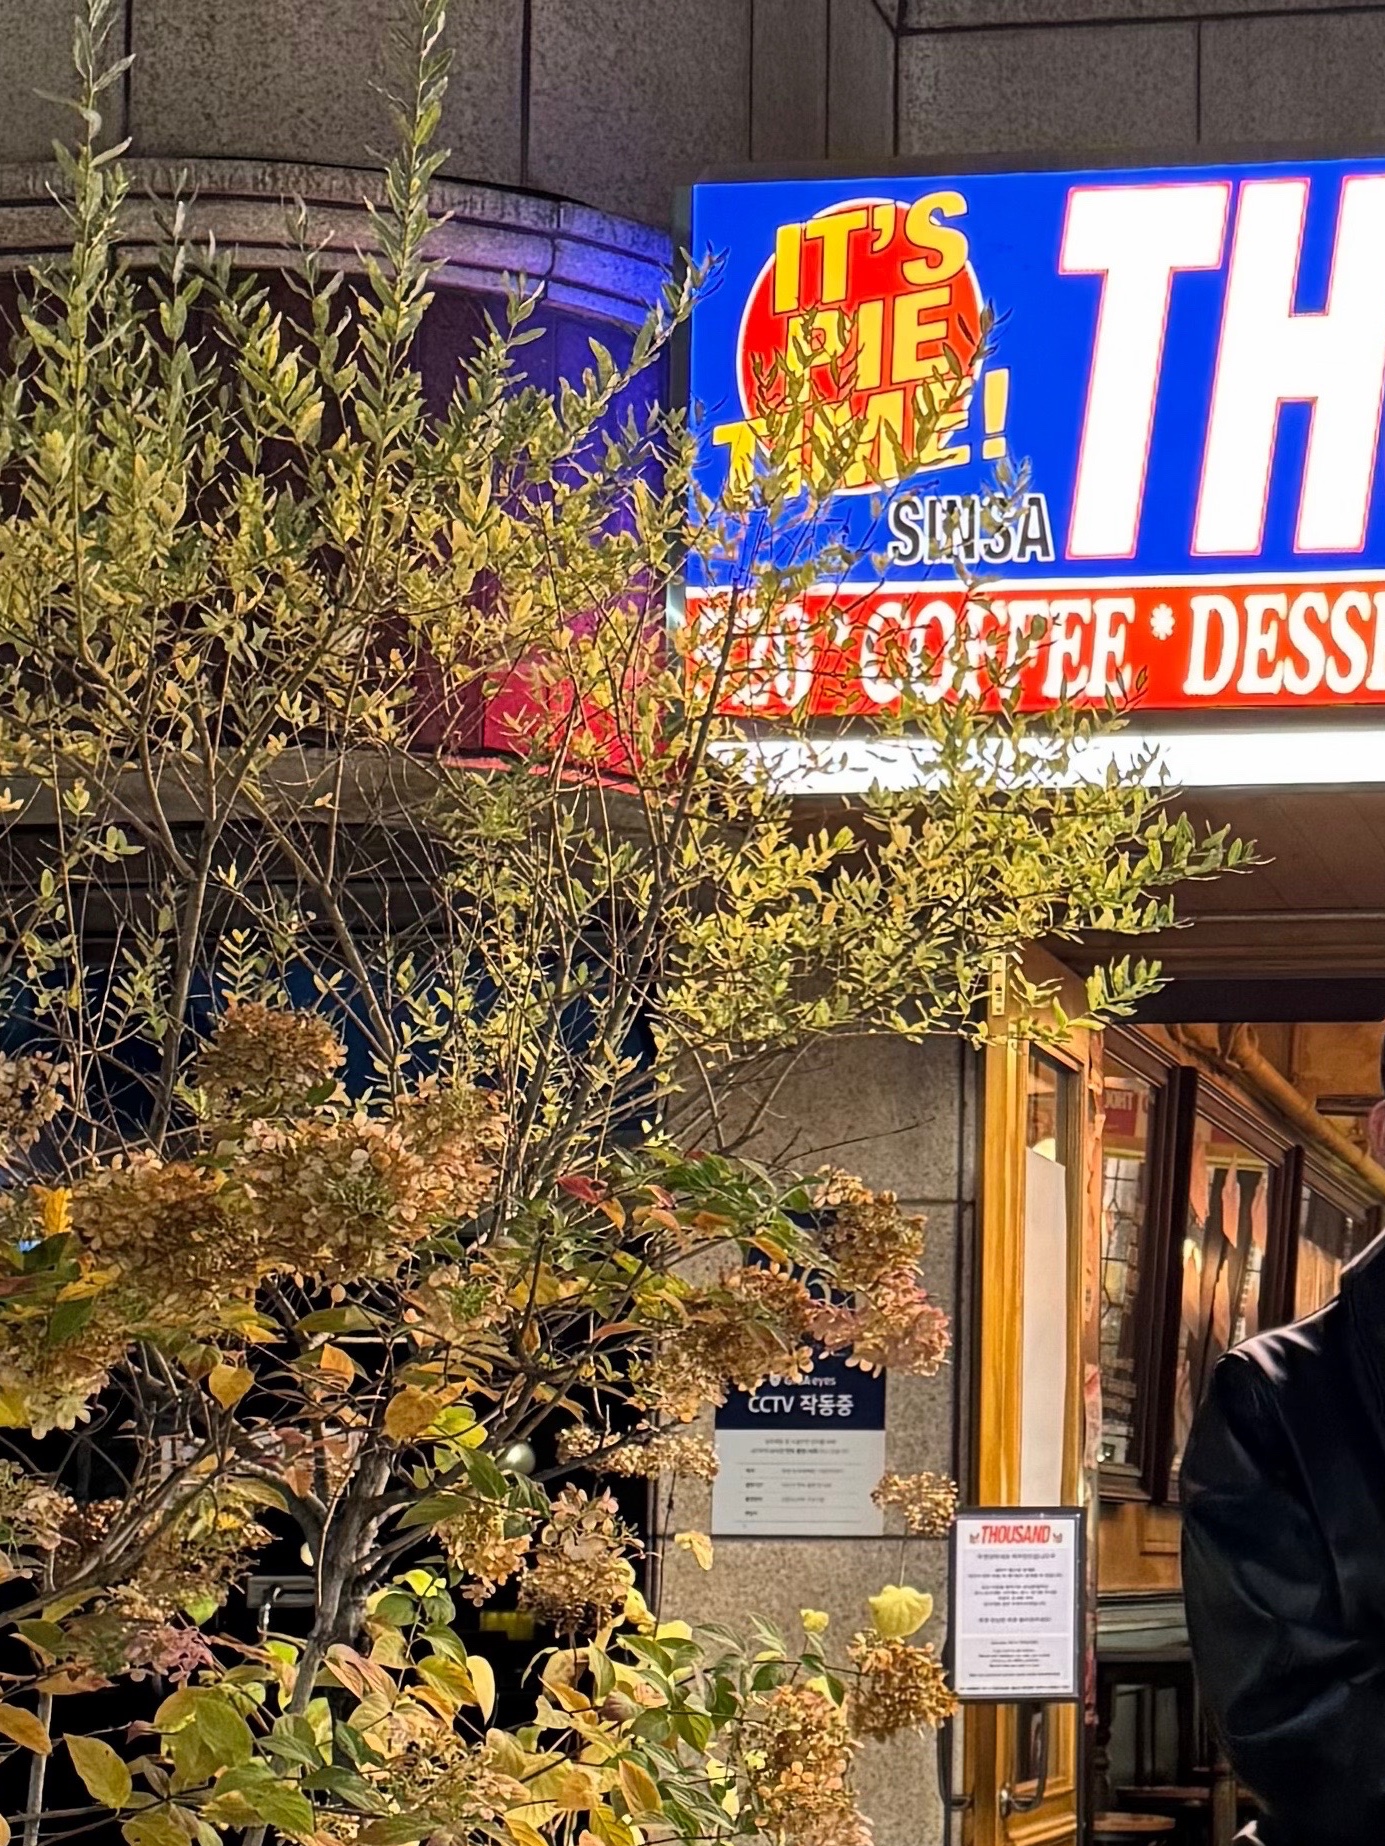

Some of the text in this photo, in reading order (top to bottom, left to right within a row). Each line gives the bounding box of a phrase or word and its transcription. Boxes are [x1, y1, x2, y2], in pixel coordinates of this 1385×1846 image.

[773, 190, 969, 315] IT'S
[784, 284, 952, 405] PIE
[887, 492, 1055, 566] SINSA
[859, 597, 1136, 705] COFFEE
[747, 1393, 855, 1417] CCTV 작동중
[981, 1524, 1052, 1544] THOUSAND
